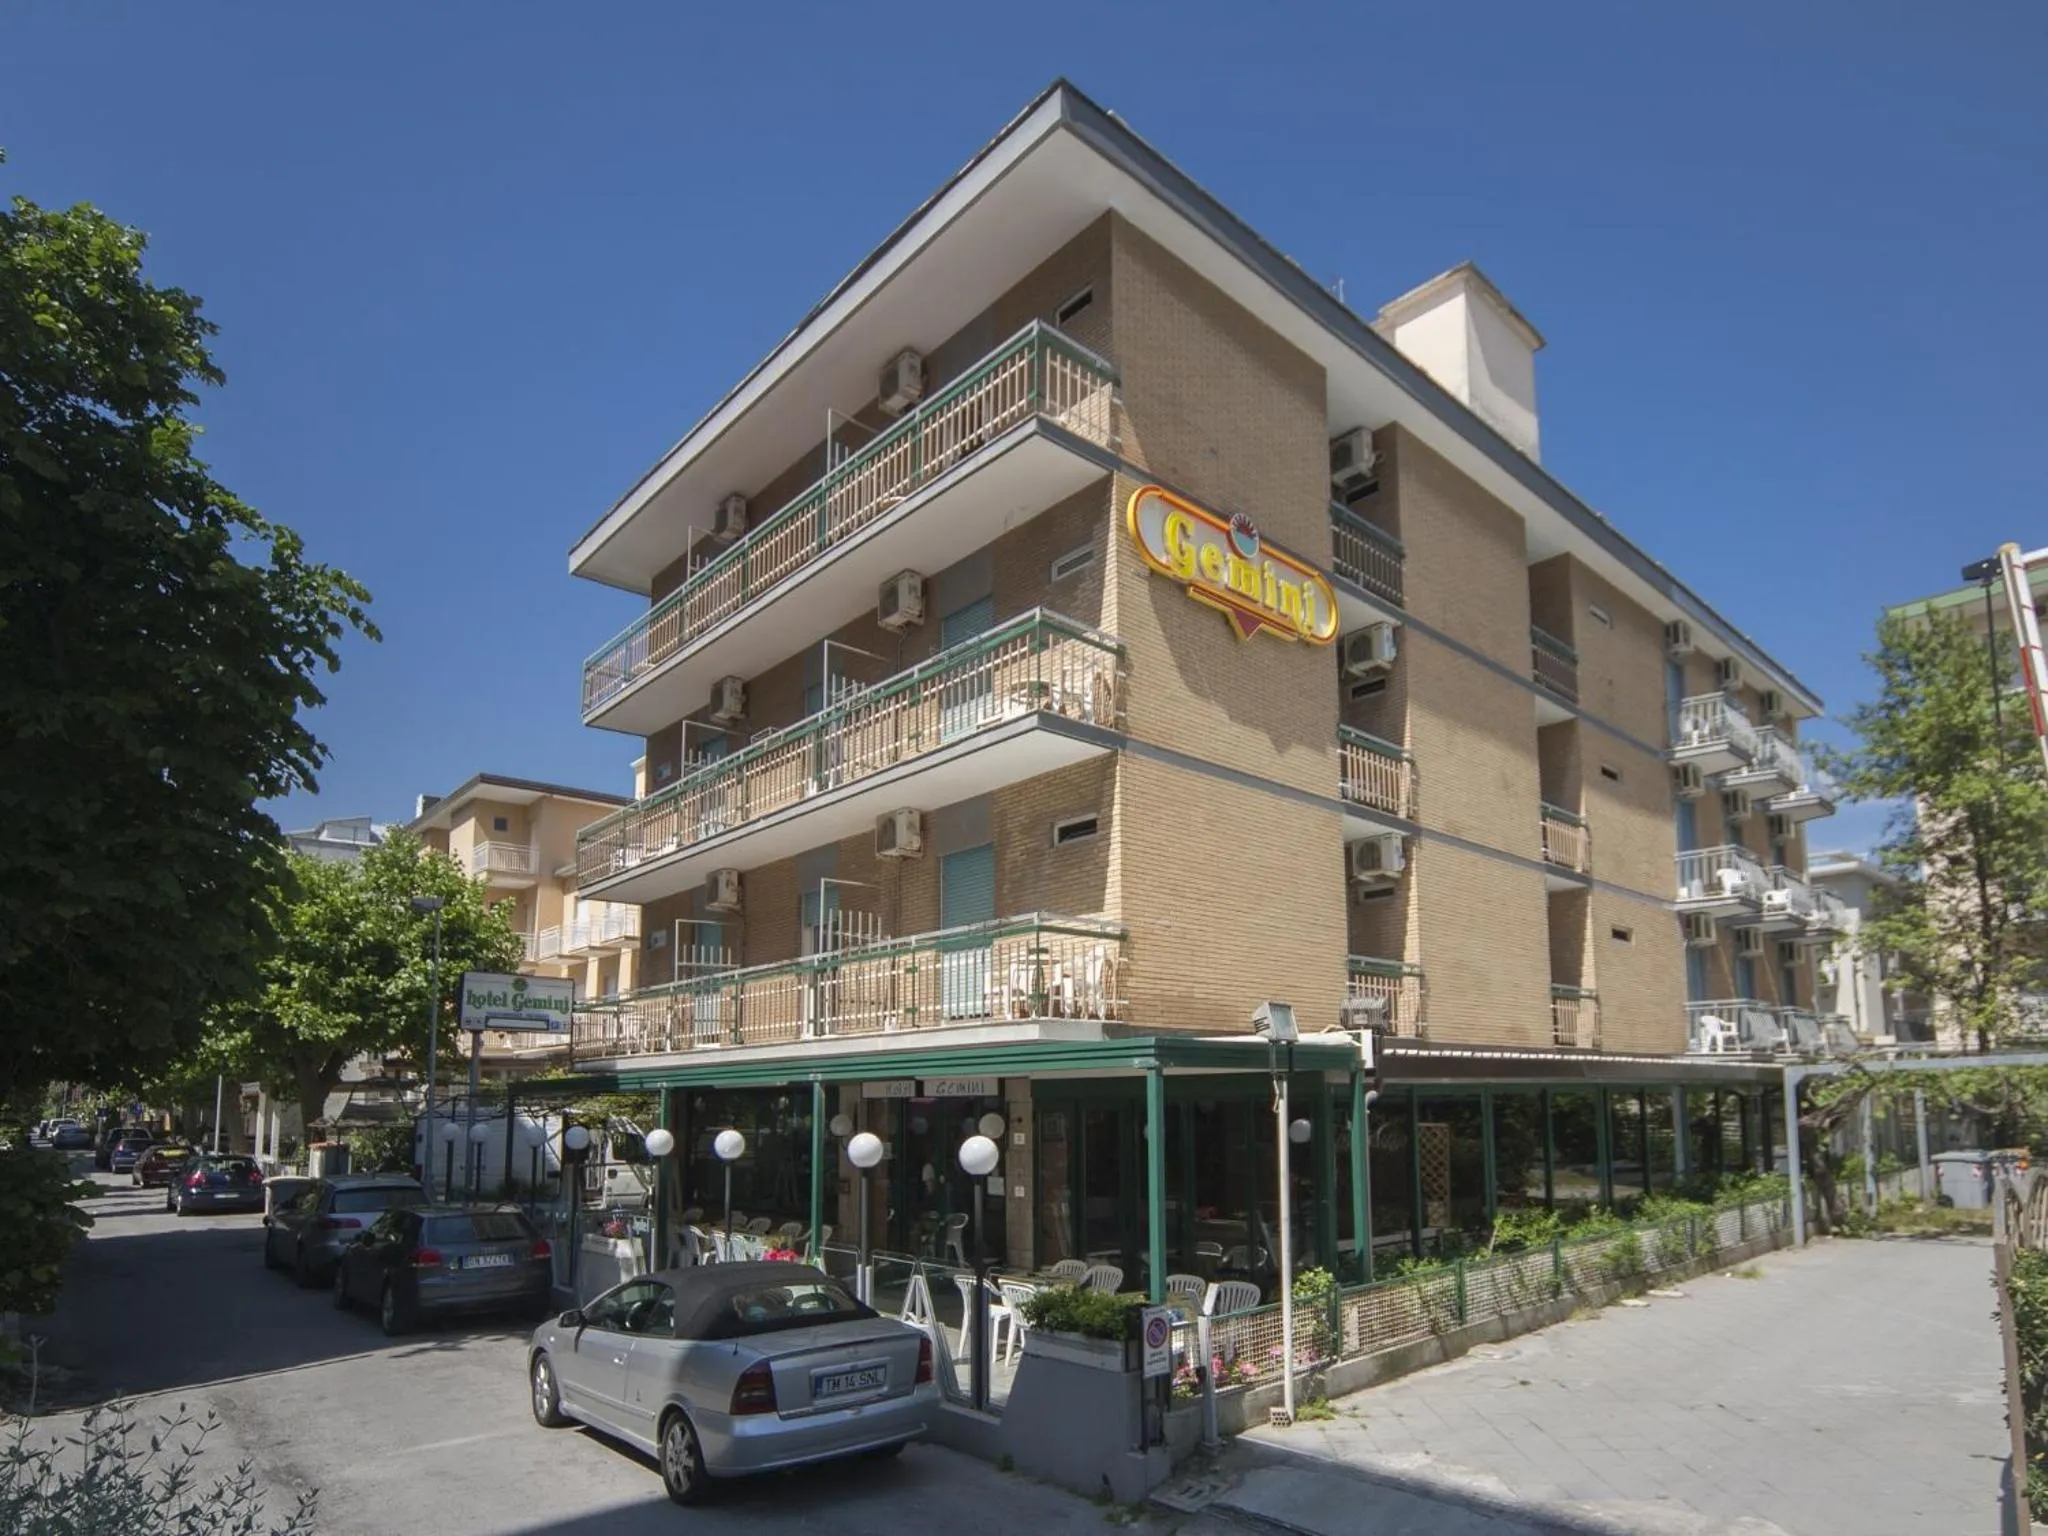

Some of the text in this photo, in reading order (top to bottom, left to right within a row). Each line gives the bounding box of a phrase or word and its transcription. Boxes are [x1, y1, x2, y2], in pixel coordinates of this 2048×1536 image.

[1163, 510, 1317, 638] Gemini
[466, 989, 570, 1015] hotel Gemini
